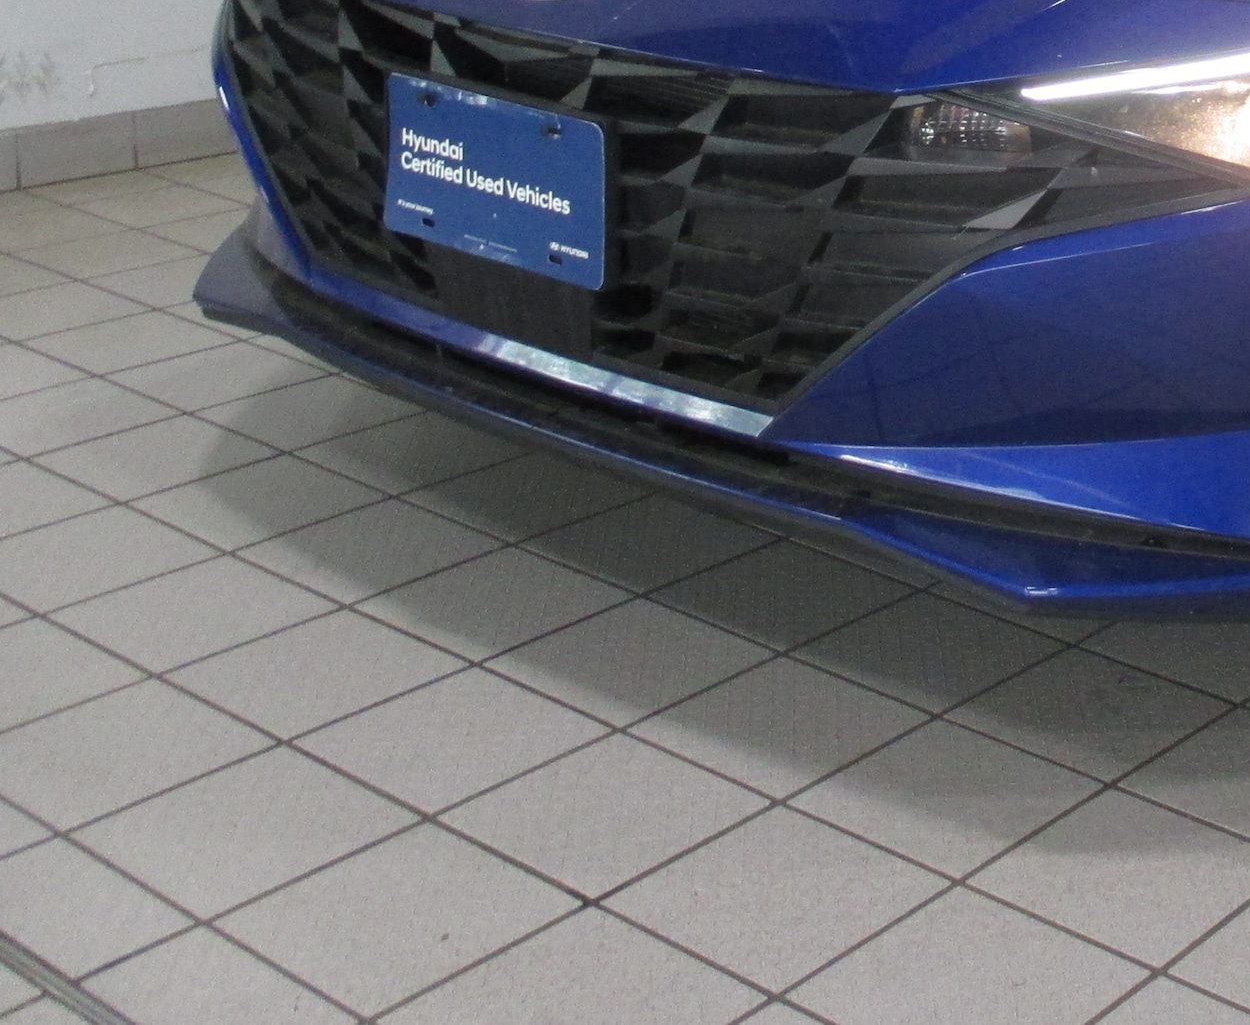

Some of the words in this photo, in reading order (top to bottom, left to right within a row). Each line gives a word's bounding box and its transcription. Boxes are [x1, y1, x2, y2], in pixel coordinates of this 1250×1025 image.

[401, 127, 464, 161] Hyundai
[400, 150, 464, 184] Certified
[465, 168, 504, 196] Used
[505, 179, 571, 215] Vehicles
